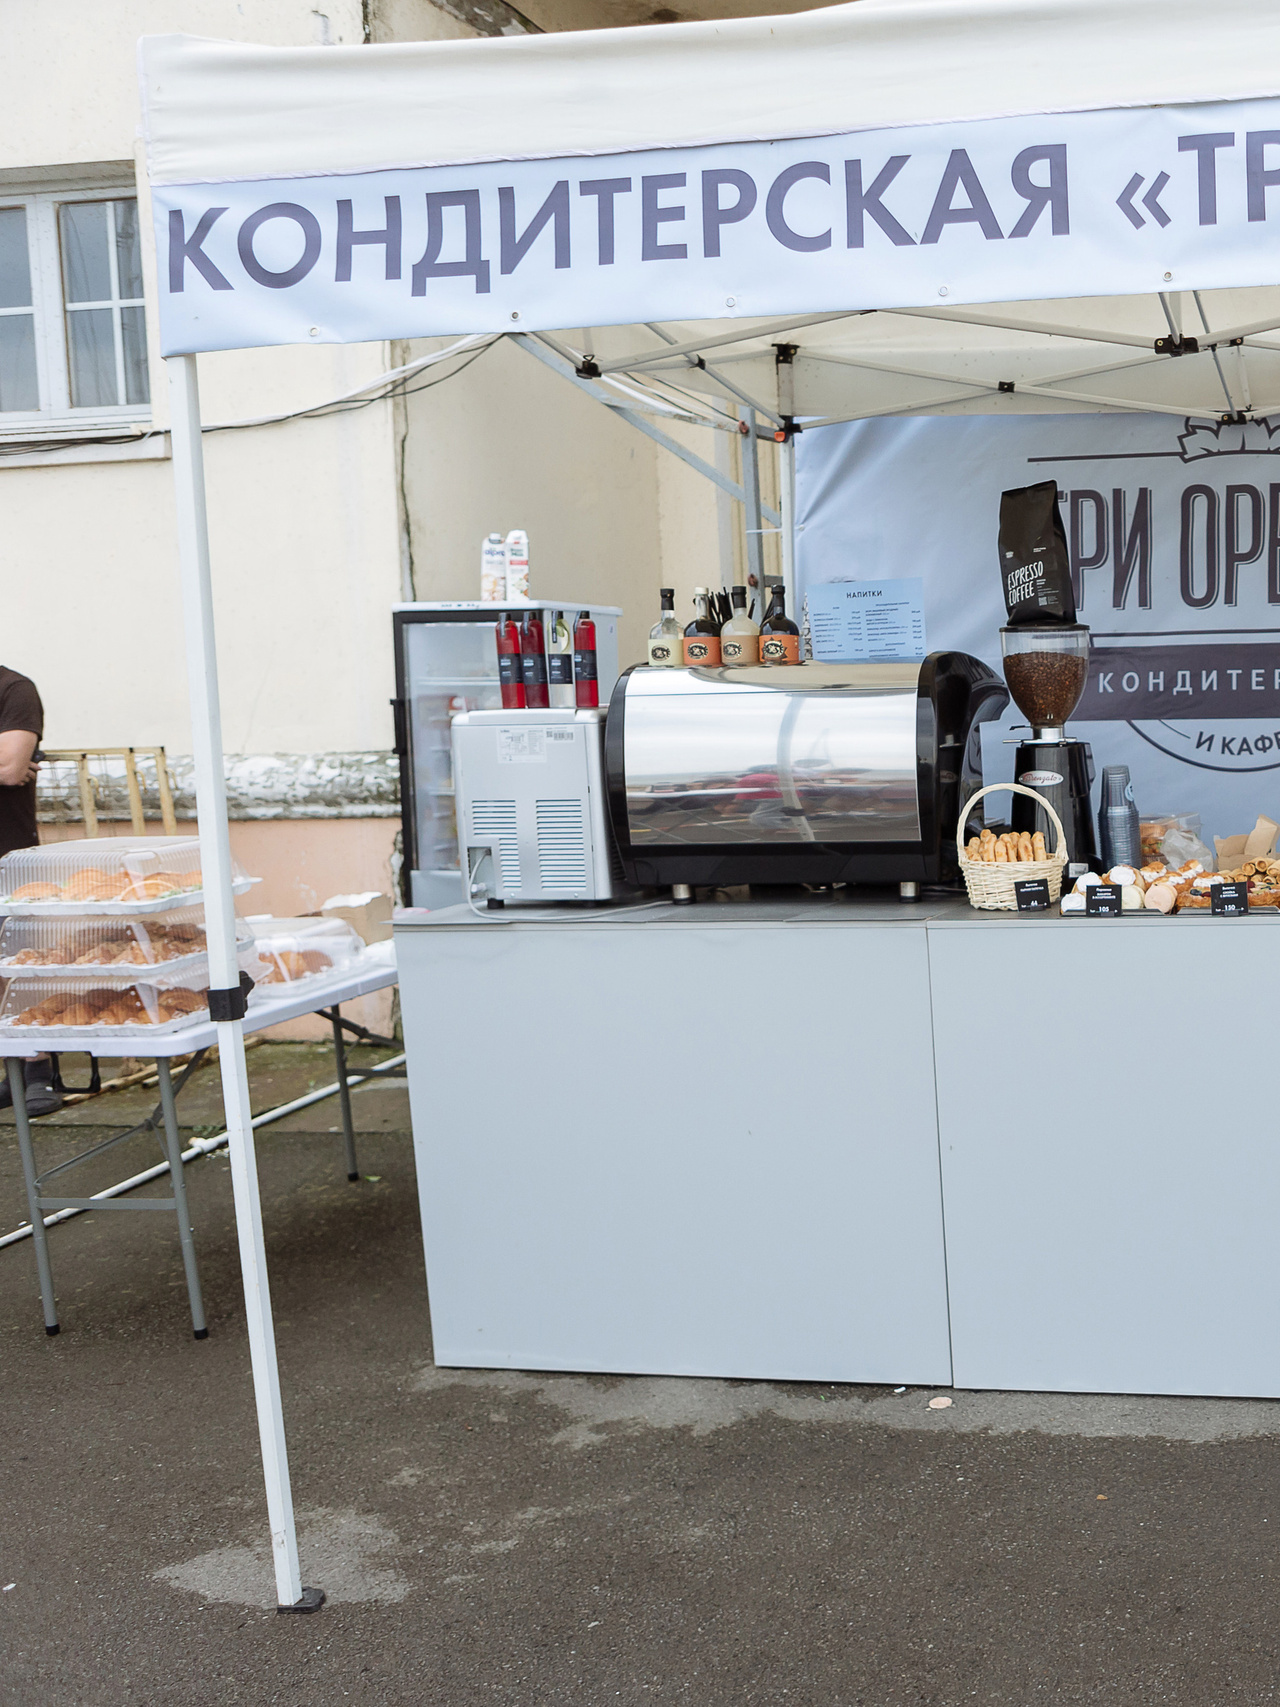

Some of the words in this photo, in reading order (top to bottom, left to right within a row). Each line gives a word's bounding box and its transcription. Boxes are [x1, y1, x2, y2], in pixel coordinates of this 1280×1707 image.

[167, 143, 1069, 297] КОНДИТЕРСКАЯ
[1057, 487, 1152, 611] РИ
[1007, 560, 1044, 591] ESPRESSO
[846, 590, 883, 599] НАПИТКИ
[1008, 580, 1035, 606] COFFEE
[1195, 731, 1215, 753] И
